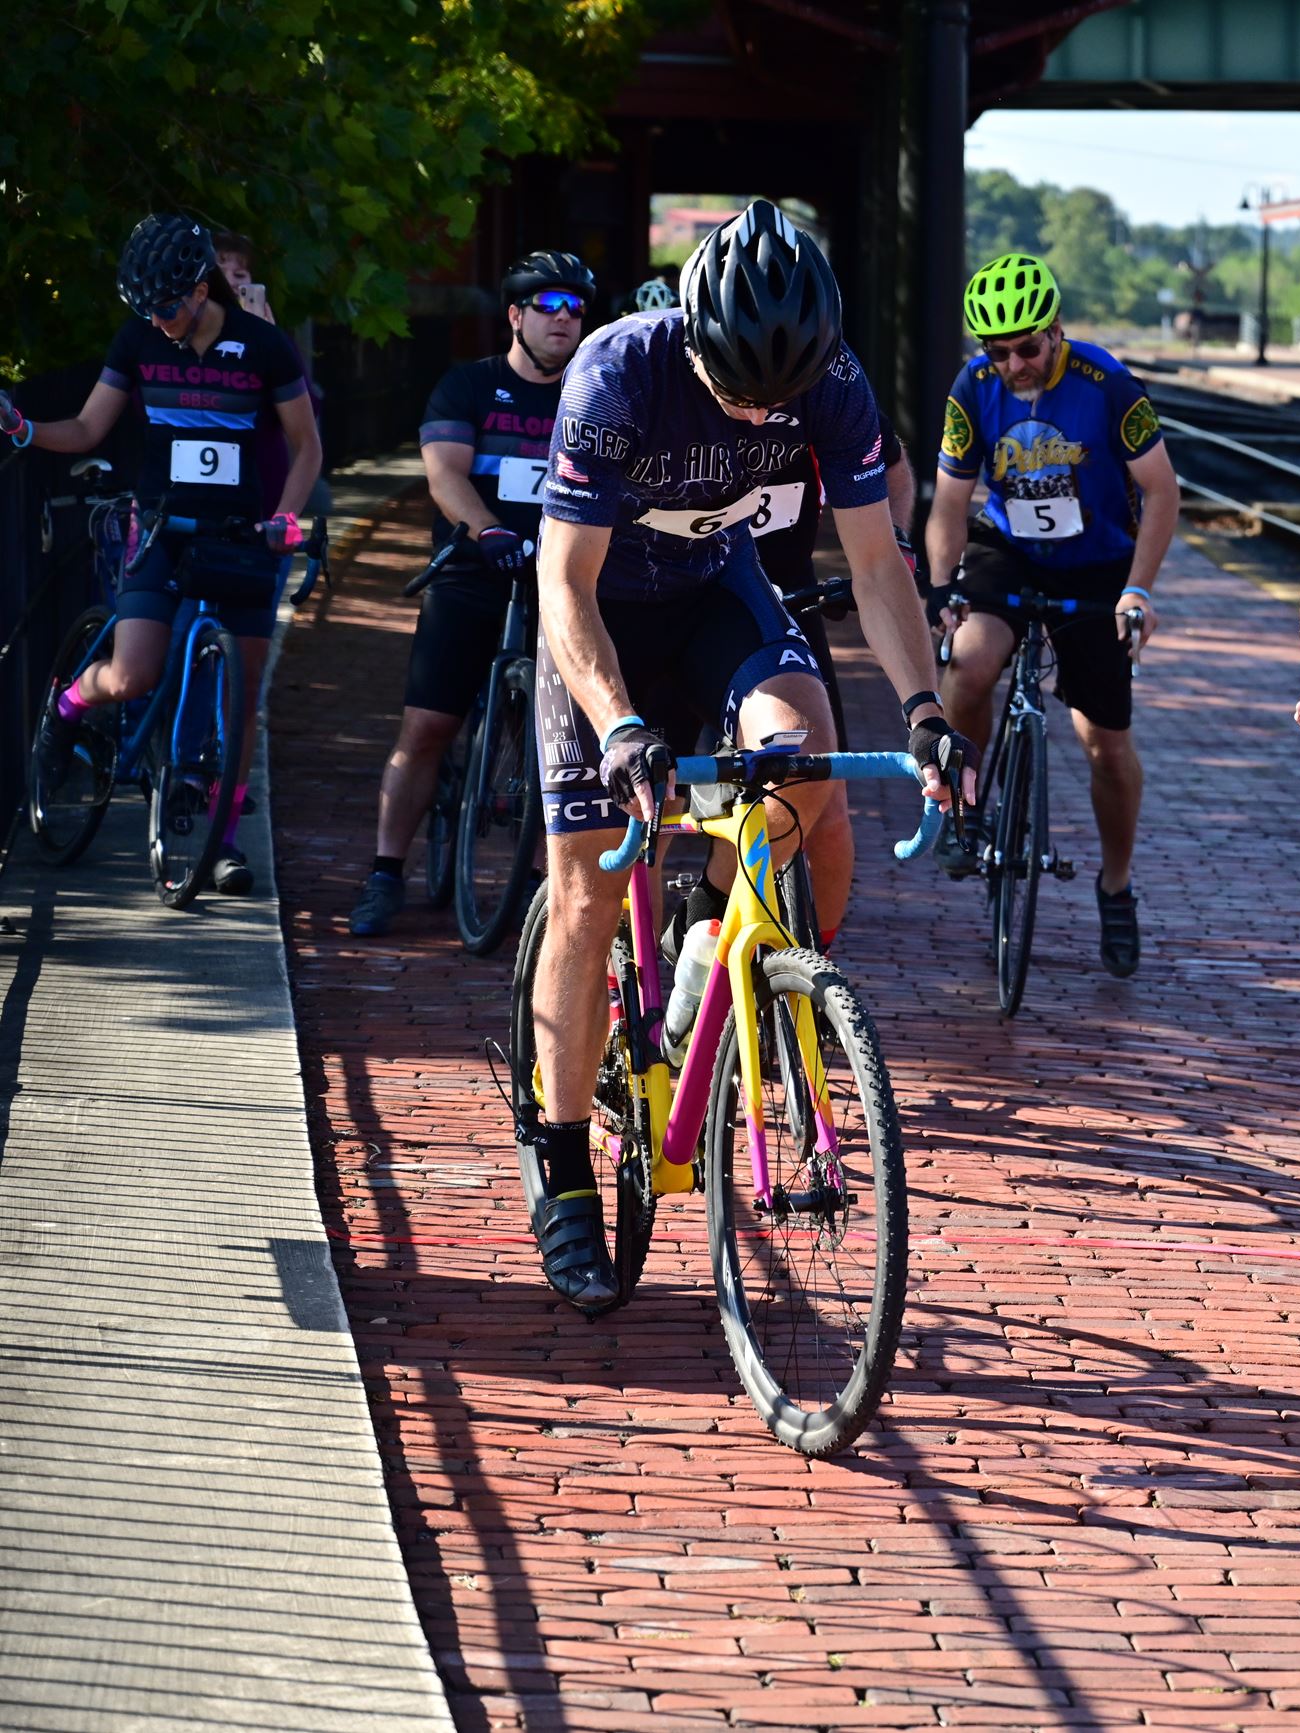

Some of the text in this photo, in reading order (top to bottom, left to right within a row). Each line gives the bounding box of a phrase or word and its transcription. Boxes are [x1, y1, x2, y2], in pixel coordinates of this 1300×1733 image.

[139, 364, 263, 389] VELOPIGS
[179, 392, 222, 408] BBSC
[199, 446, 220, 477] 9
[684, 442, 733, 484] AIR
[530, 465, 549, 496] 7
[688, 511, 729, 536] 6
[750, 492, 772, 529] 8
[1033, 504, 1056, 532] 5
[552, 731, 567, 742] 23
[545, 798, 614, 824] FCT
